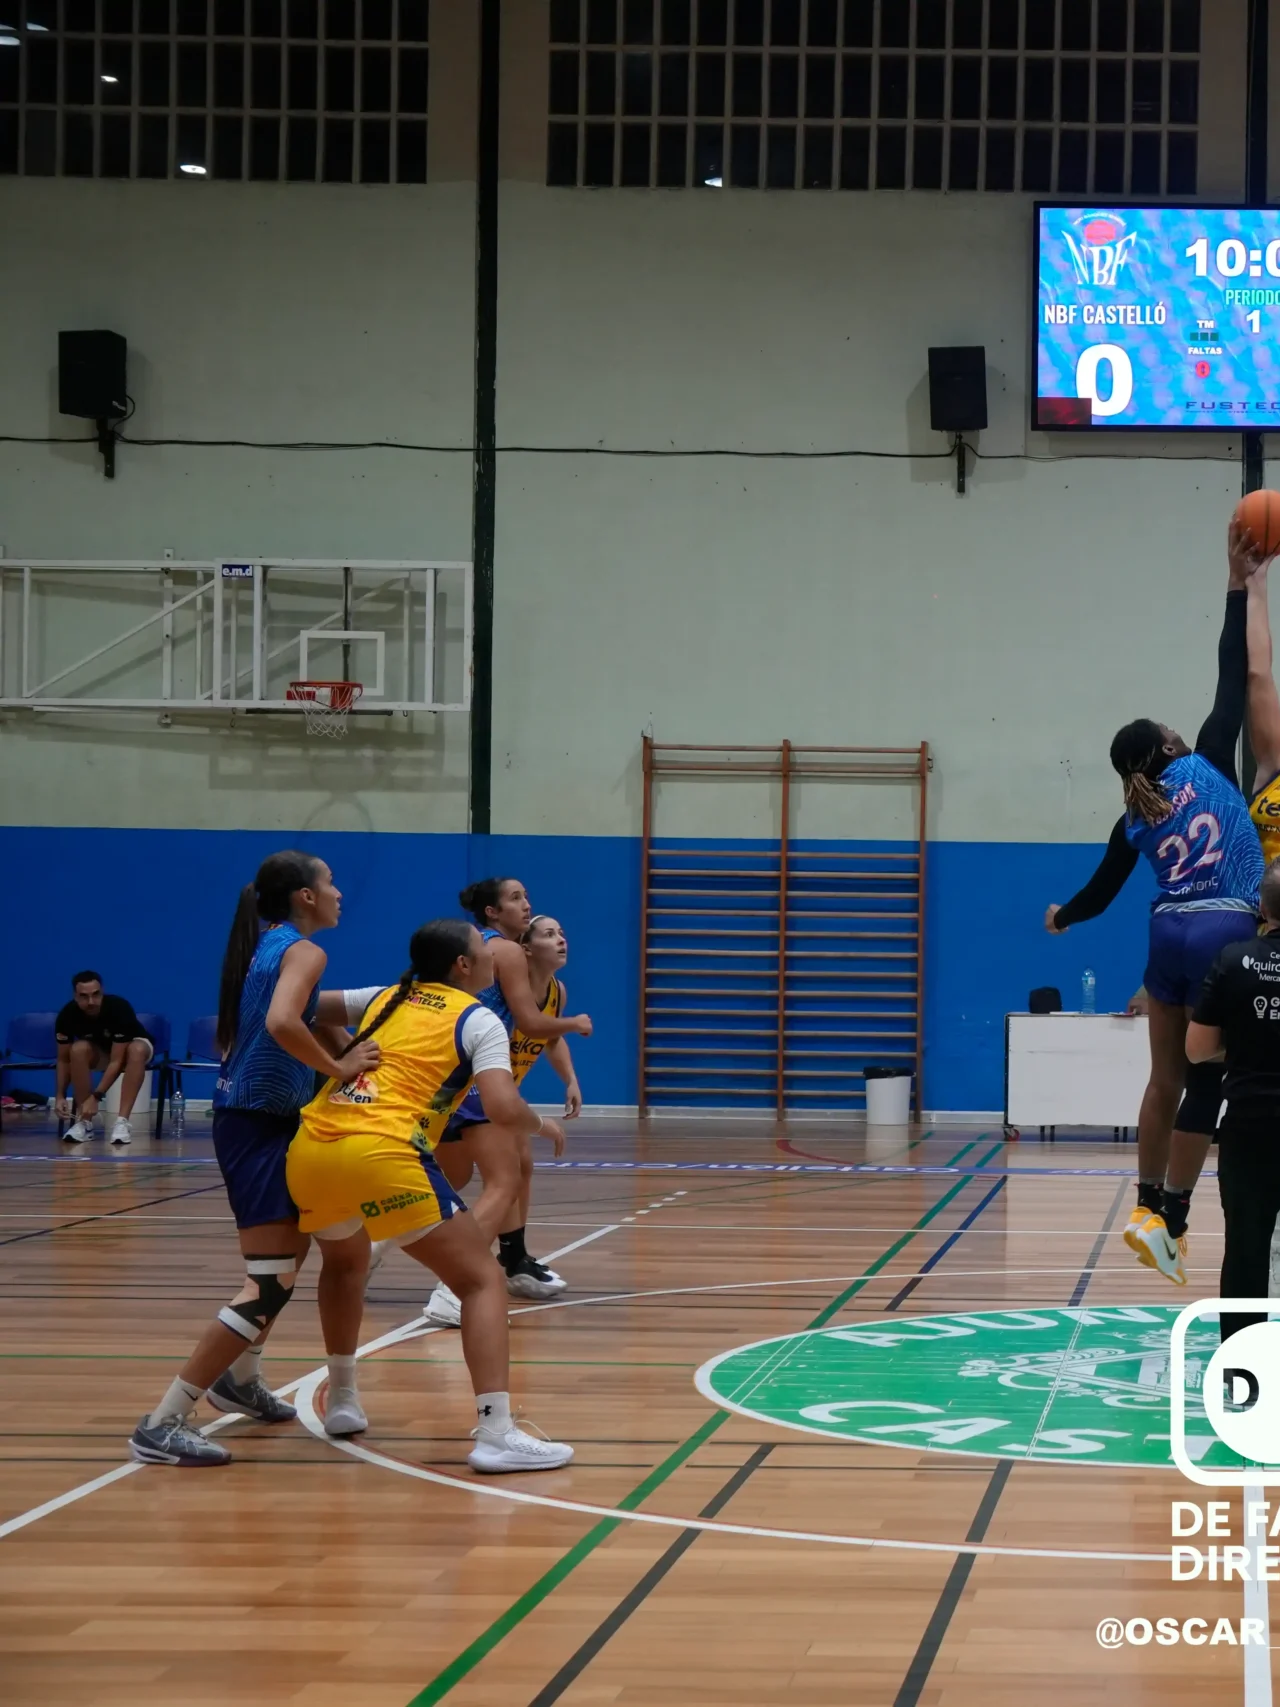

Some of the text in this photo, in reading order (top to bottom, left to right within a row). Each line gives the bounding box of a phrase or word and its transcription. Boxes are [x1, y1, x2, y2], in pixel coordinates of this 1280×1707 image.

[1061, 229, 1138, 286] NBF
[1044, 301, 1166, 325] NBF CASTELLÓ
[1246, 309, 1261, 333] 1
[1197, 320, 1214, 329] TM
[1187, 347, 1223, 355] FALTAS
[1195, 361, 1211, 379] 0
[1075, 343, 1133, 417] 0
[222, 565, 253, 577] e.m.d
[1157, 813, 1223, 883] 22
[509, 1037, 545, 1055] eika
[380, 1192, 412, 1206] caixa
[383, 1193, 433, 1213] popular
